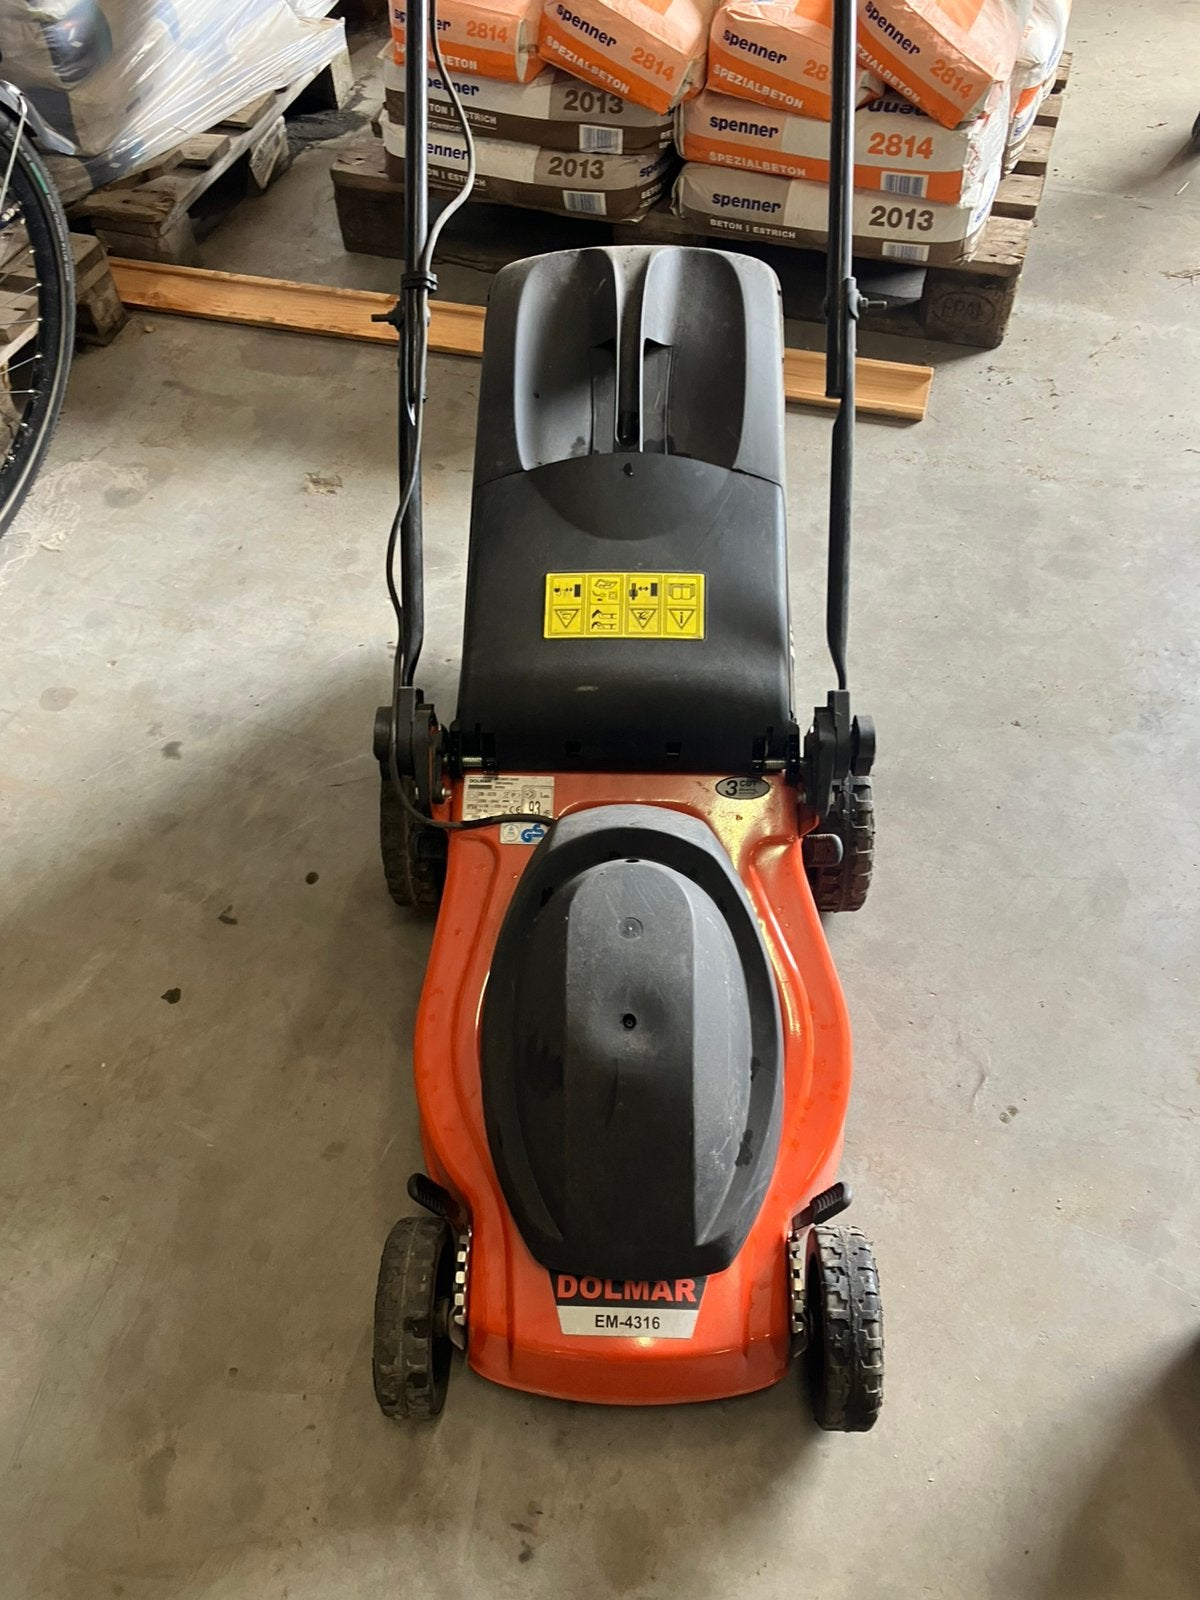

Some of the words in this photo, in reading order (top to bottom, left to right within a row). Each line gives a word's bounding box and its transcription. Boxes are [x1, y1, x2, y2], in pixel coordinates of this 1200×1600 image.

[466, 20, 508, 43] 2814
[555, 2, 617, 48] spenner
[865, 1, 920, 55] spenner
[722, 28, 788, 65] spenner
[545, 35, 630, 95] SPEZIALBETON
[631, 47, 676, 81] 2814
[803, 60, 832, 82] 28
[712, 64, 805, 110] SPEZIALBETON
[930, 59, 974, 98] 2814
[563, 89, 624, 115] 2013
[709, 115, 779, 139] spenner
[427, 143, 468, 161] enner
[867, 132, 934, 160] 2814
[548, 157, 605, 180] 2013
[709, 151, 806, 177] SPEZIALBETON
[712, 192, 782, 214] spenner
[709, 218, 743, 233] BETON
[753, 226, 796, 239] ESTRICH
[869, 206, 934, 231] 2013
[725, 780, 738, 796] 3
[557, 1274, 697, 1302] DOLMAR
[595, 1314, 661, 1330] EM-4316
